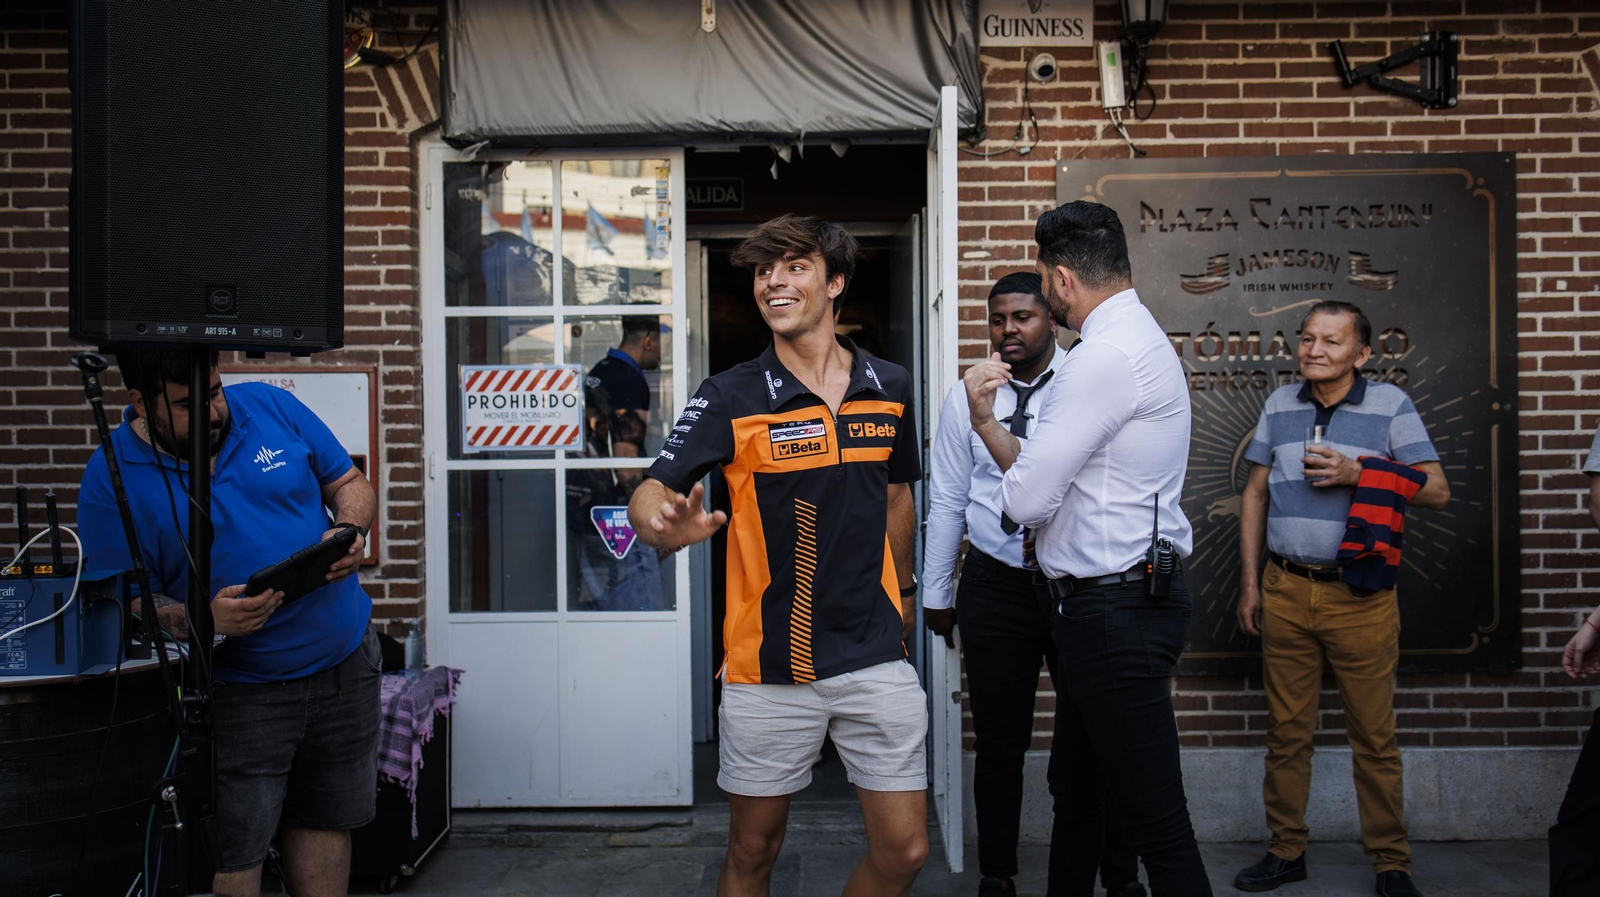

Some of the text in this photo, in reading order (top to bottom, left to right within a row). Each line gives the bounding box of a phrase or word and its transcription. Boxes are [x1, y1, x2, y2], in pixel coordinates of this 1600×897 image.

[983, 14, 1084, 39] GUINNESS
[686, 185, 738, 203] ALIDA
[1140, 197, 1433, 233] PLAZA CANTERBURY
[1235, 249, 1341, 277] JAMESON
[1243, 282, 1335, 292] IRISH WHISKEY
[212, 295, 231, 306] RCF
[204, 327, 217, 335] ART
[1184, 370, 1268, 391] ENOS
[468, 393, 577, 409] PROHIBIDO
[483, 412, 510, 420] MOVER
[520, 411, 562, 419] MOBILIARIO
[864, 422, 897, 438] Beta
[790, 441, 822, 455] Beta
